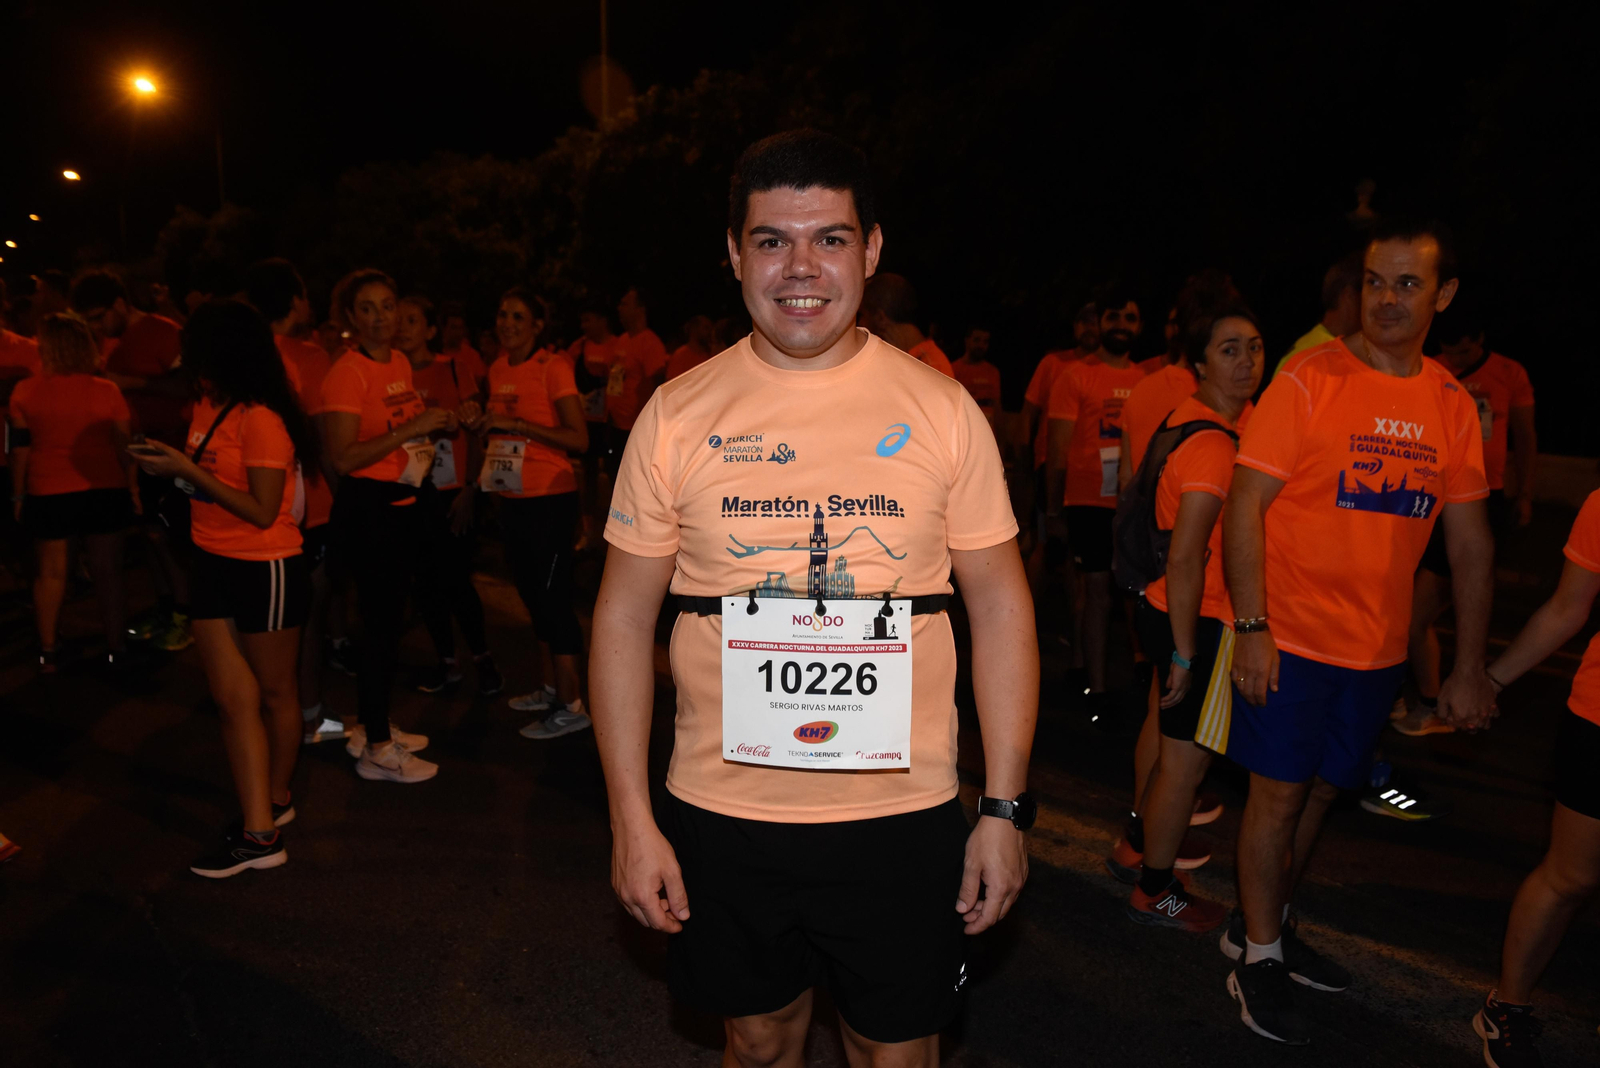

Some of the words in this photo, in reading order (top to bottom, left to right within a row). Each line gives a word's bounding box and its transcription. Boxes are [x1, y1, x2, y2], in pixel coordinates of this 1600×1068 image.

[1374, 417, 1424, 440] XXXV
[726, 435, 762, 444] ZURICH
[1350, 434, 1392, 445] CARRERA
[1396, 440, 1437, 454] NOCTURNA
[724, 445, 763, 454] MARATÓN
[1357, 443, 1437, 464] GUADALQUIVIR
[721, 496, 809, 513] Maratón
[827, 494, 904, 513] Sevilla.
[750, 642, 778, 650] CARRERA
[758, 659, 878, 696] 10226
[769, 701, 800, 710] SERGIO
[801, 703, 826, 711] RIVAS
[828, 704, 863, 712] MARTOS
